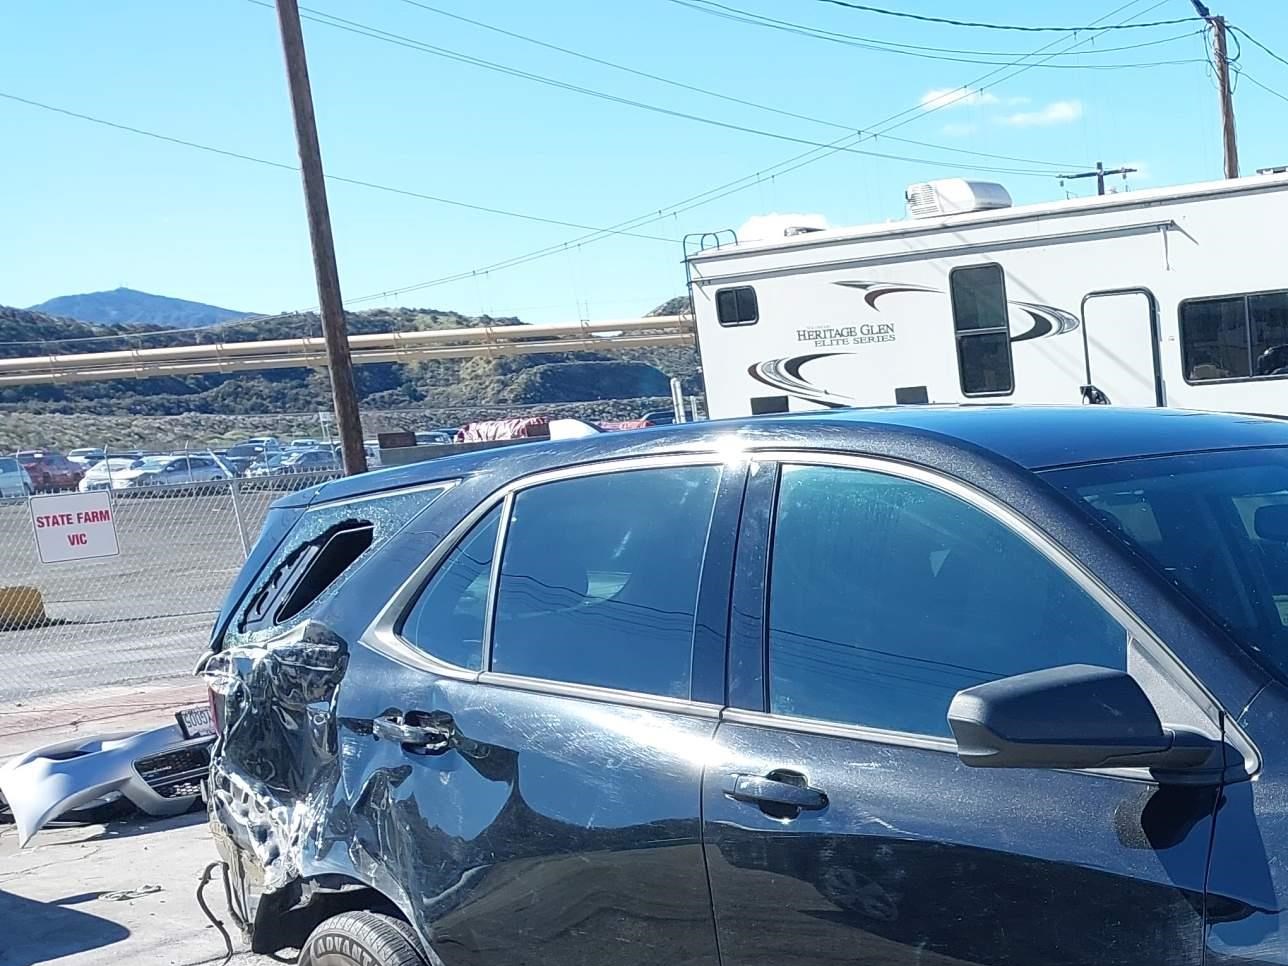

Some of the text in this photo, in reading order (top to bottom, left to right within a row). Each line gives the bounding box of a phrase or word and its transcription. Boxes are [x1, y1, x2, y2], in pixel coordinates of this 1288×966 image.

[796, 323, 895, 341] HERITAGE GLEN
[814, 334, 896, 347] ELITE SERIES
[36, 510, 110, 528] STATE FARM
[67, 533, 88, 546] VIC
